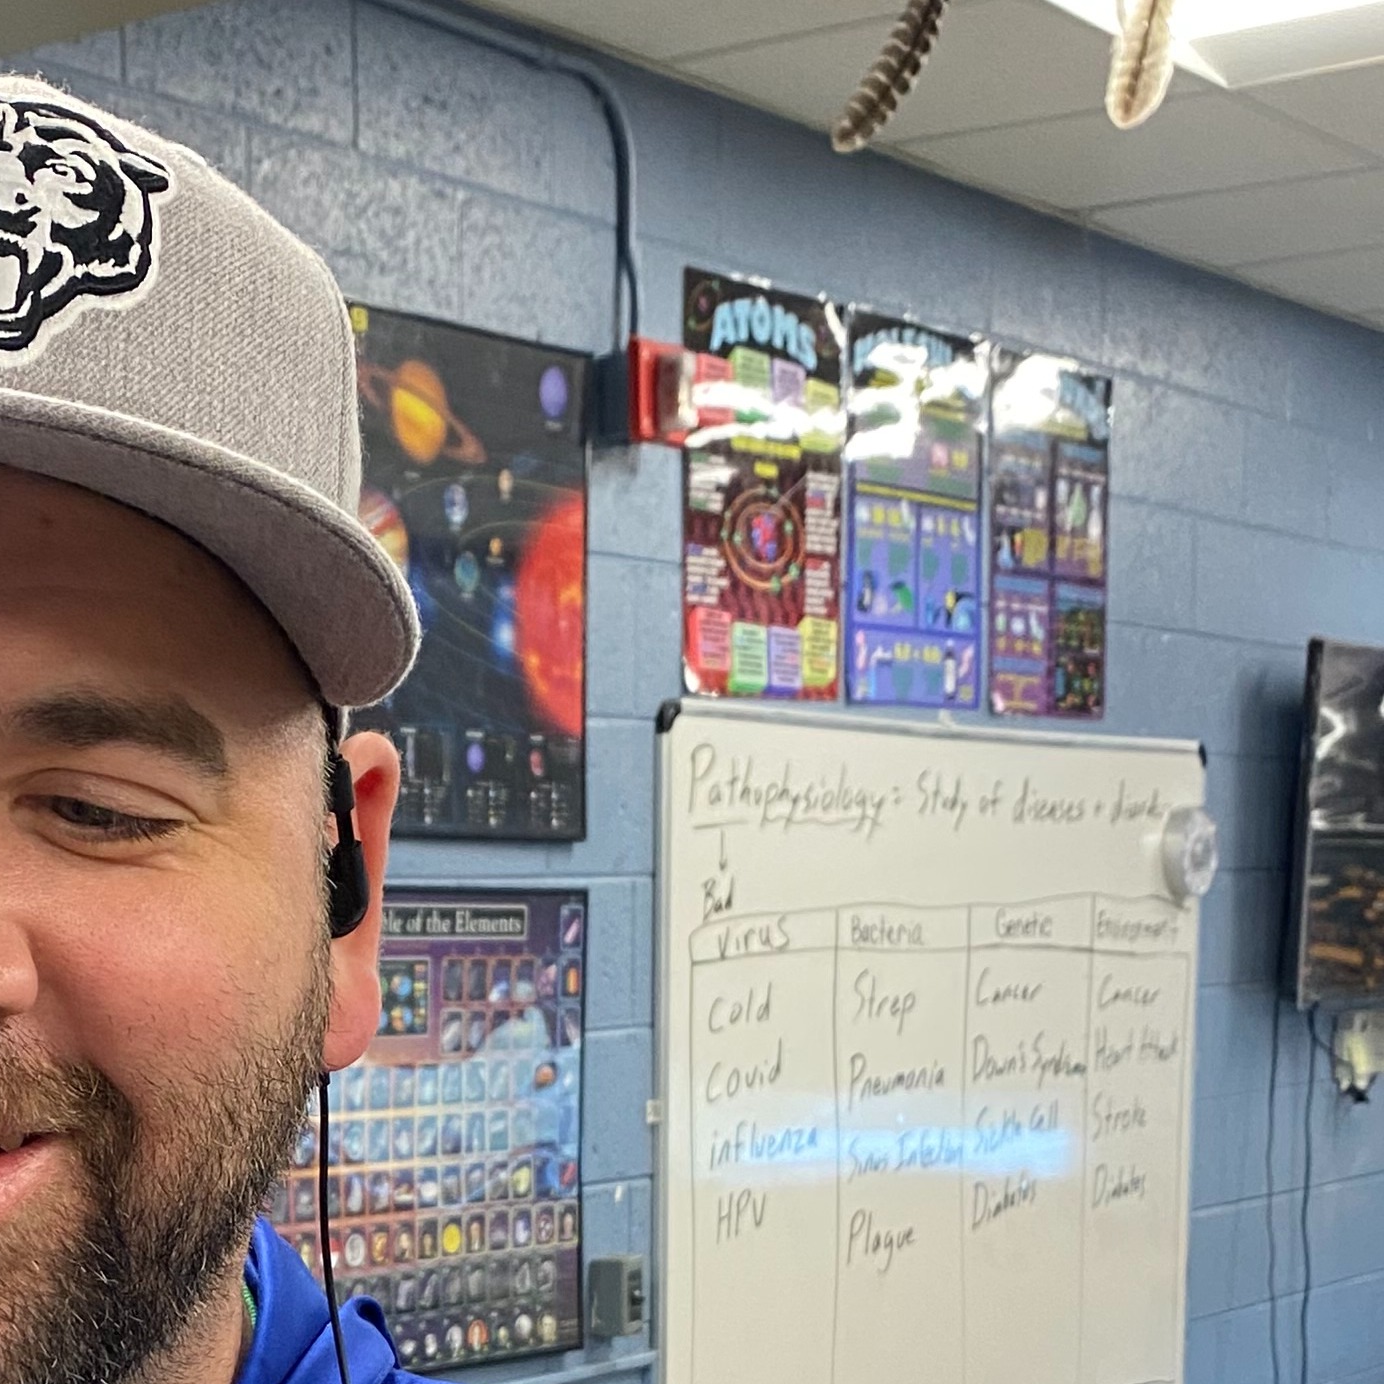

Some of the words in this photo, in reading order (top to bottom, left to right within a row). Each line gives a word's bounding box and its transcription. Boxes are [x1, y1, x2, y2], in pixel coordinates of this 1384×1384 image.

[709, 297, 818, 371] ATOMS
[918, 770, 968, 831] Study
[979, 779, 1003, 816] of
[426, 909, 451, 933] the
[455, 910, 522, 933] Elements
[702, 875, 735, 924] Bad
[995, 906, 1053, 938] Genetic
[851, 914, 925, 945] Bacteria
[708, 981, 772, 1034] Cold
[853, 967, 916, 1036] Strep
[976, 967, 1045, 1008] Cancer
[706, 1037, 782, 1104] Covid
[849, 1052, 944, 1112] Pneumonia
[710, 1120, 817, 1171] influenza
[716, 1188, 766, 1245] HPV
[846, 1208, 916, 1274] Plague
